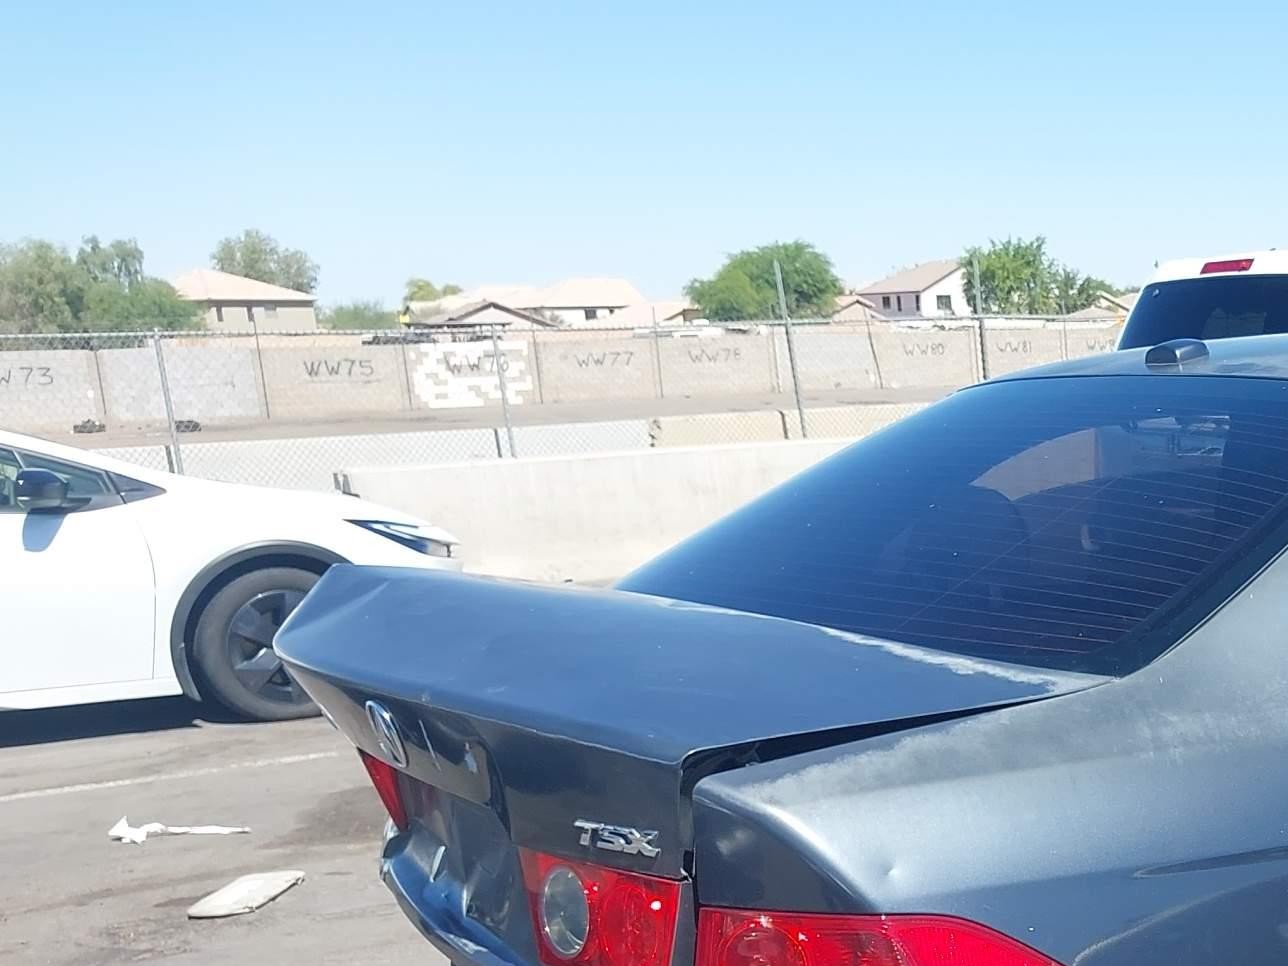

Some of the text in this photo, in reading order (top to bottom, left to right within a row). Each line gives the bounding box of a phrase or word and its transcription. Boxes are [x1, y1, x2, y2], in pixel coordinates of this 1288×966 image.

[303, 358, 375, 377] WW75
[574, 351, 634, 369] WW77
[573, 819, 662, 858] TSX
